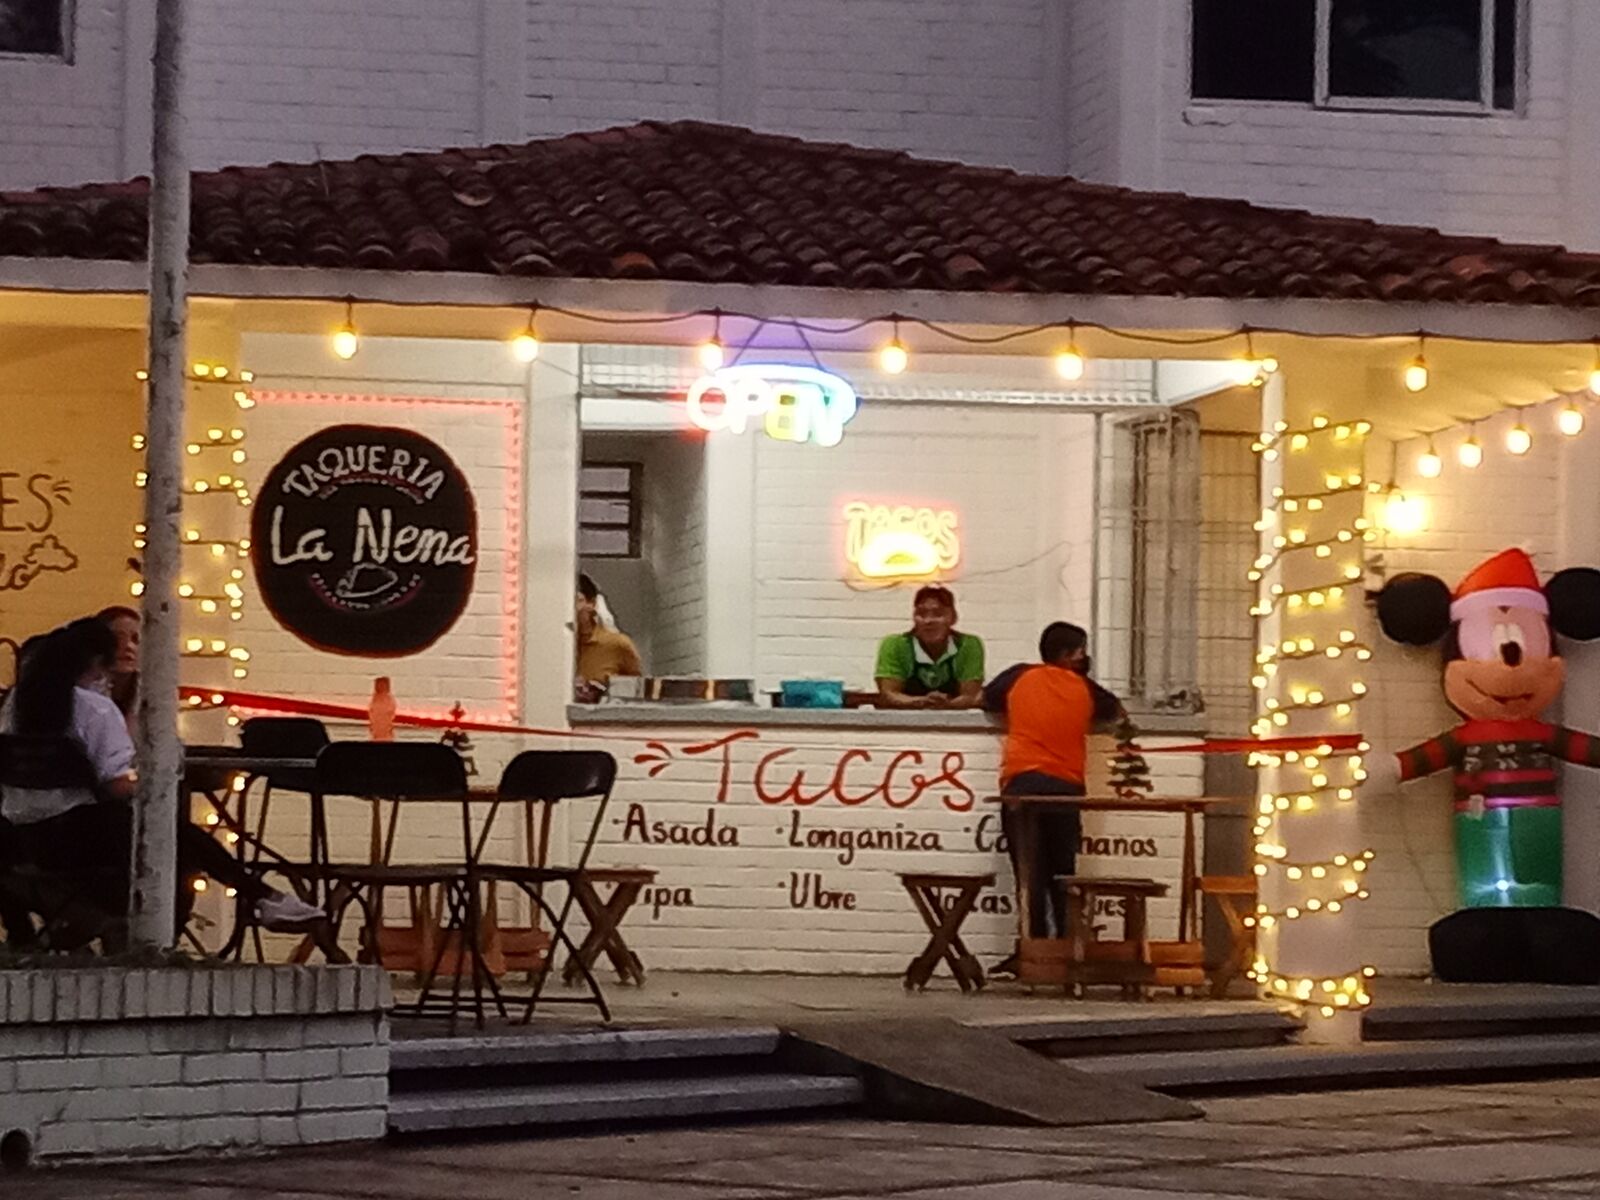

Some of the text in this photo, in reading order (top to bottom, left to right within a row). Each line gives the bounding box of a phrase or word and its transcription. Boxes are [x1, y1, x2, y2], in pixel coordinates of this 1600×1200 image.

[687, 374, 845, 447] OPEN
[282, 444, 446, 500] TAQUERIA
[271, 505, 475, 566] La Nena
[623, 803, 740, 848] Asada
[789, 809, 944, 866] Longaniza
[643, 887, 695, 921] ipa
[790, 871, 857, 911] Ubre
